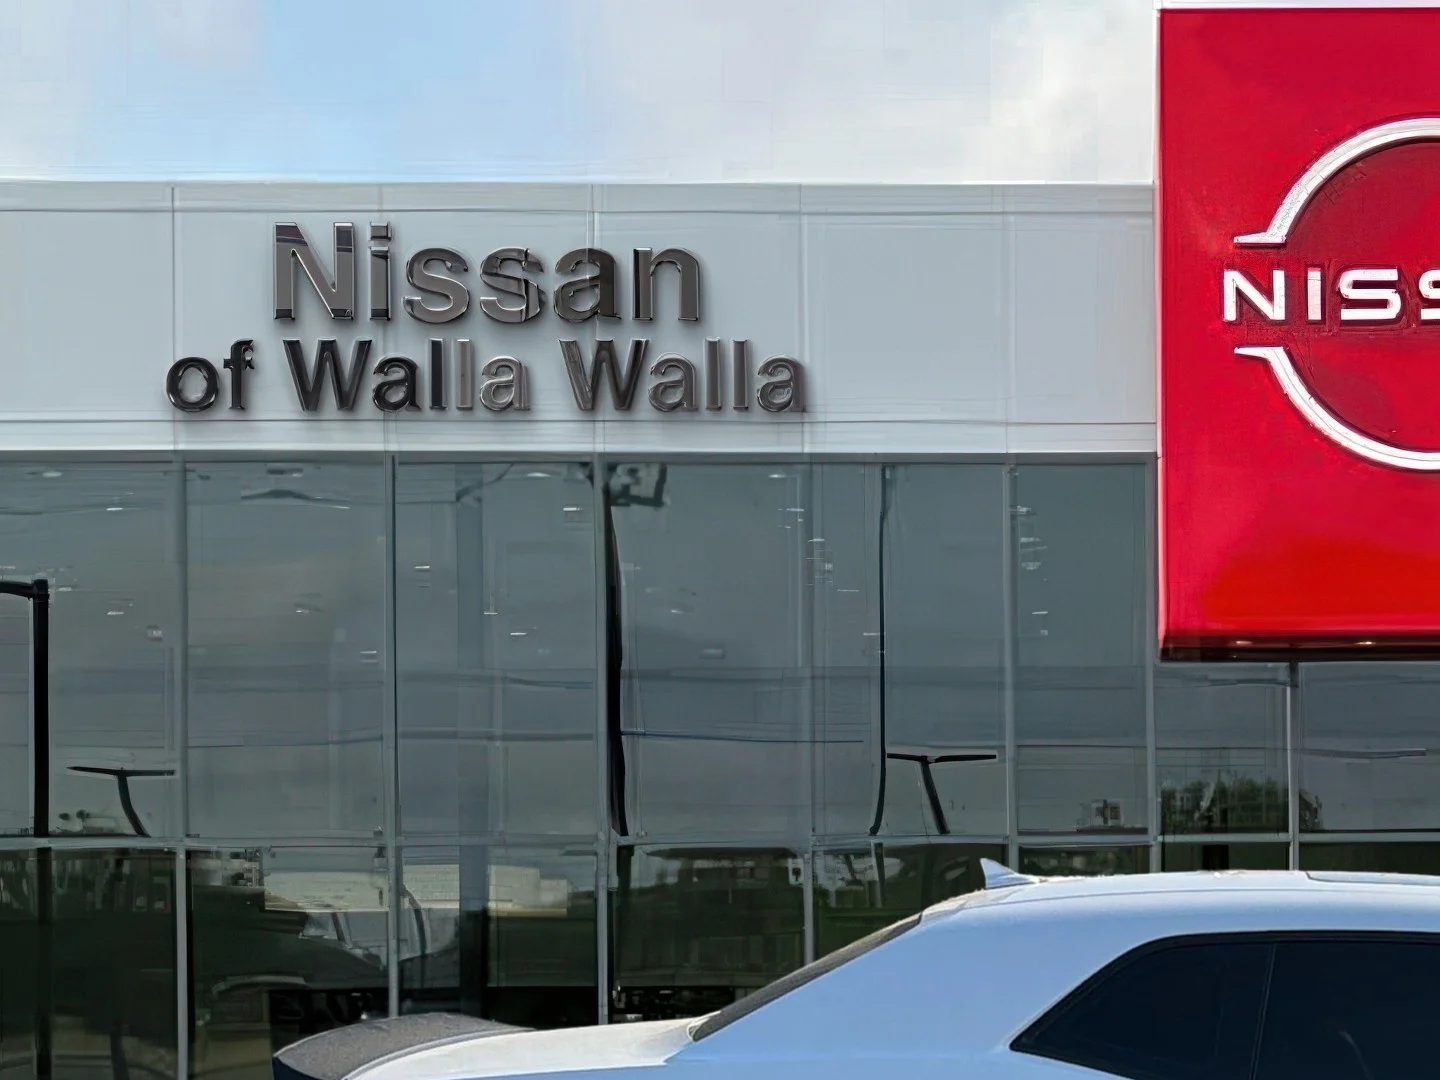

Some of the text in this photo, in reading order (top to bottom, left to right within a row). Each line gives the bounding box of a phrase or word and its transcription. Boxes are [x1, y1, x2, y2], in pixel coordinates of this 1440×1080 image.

[273, 221, 706, 324] Nissan
[165, 338, 806, 412] of Walla Walla
